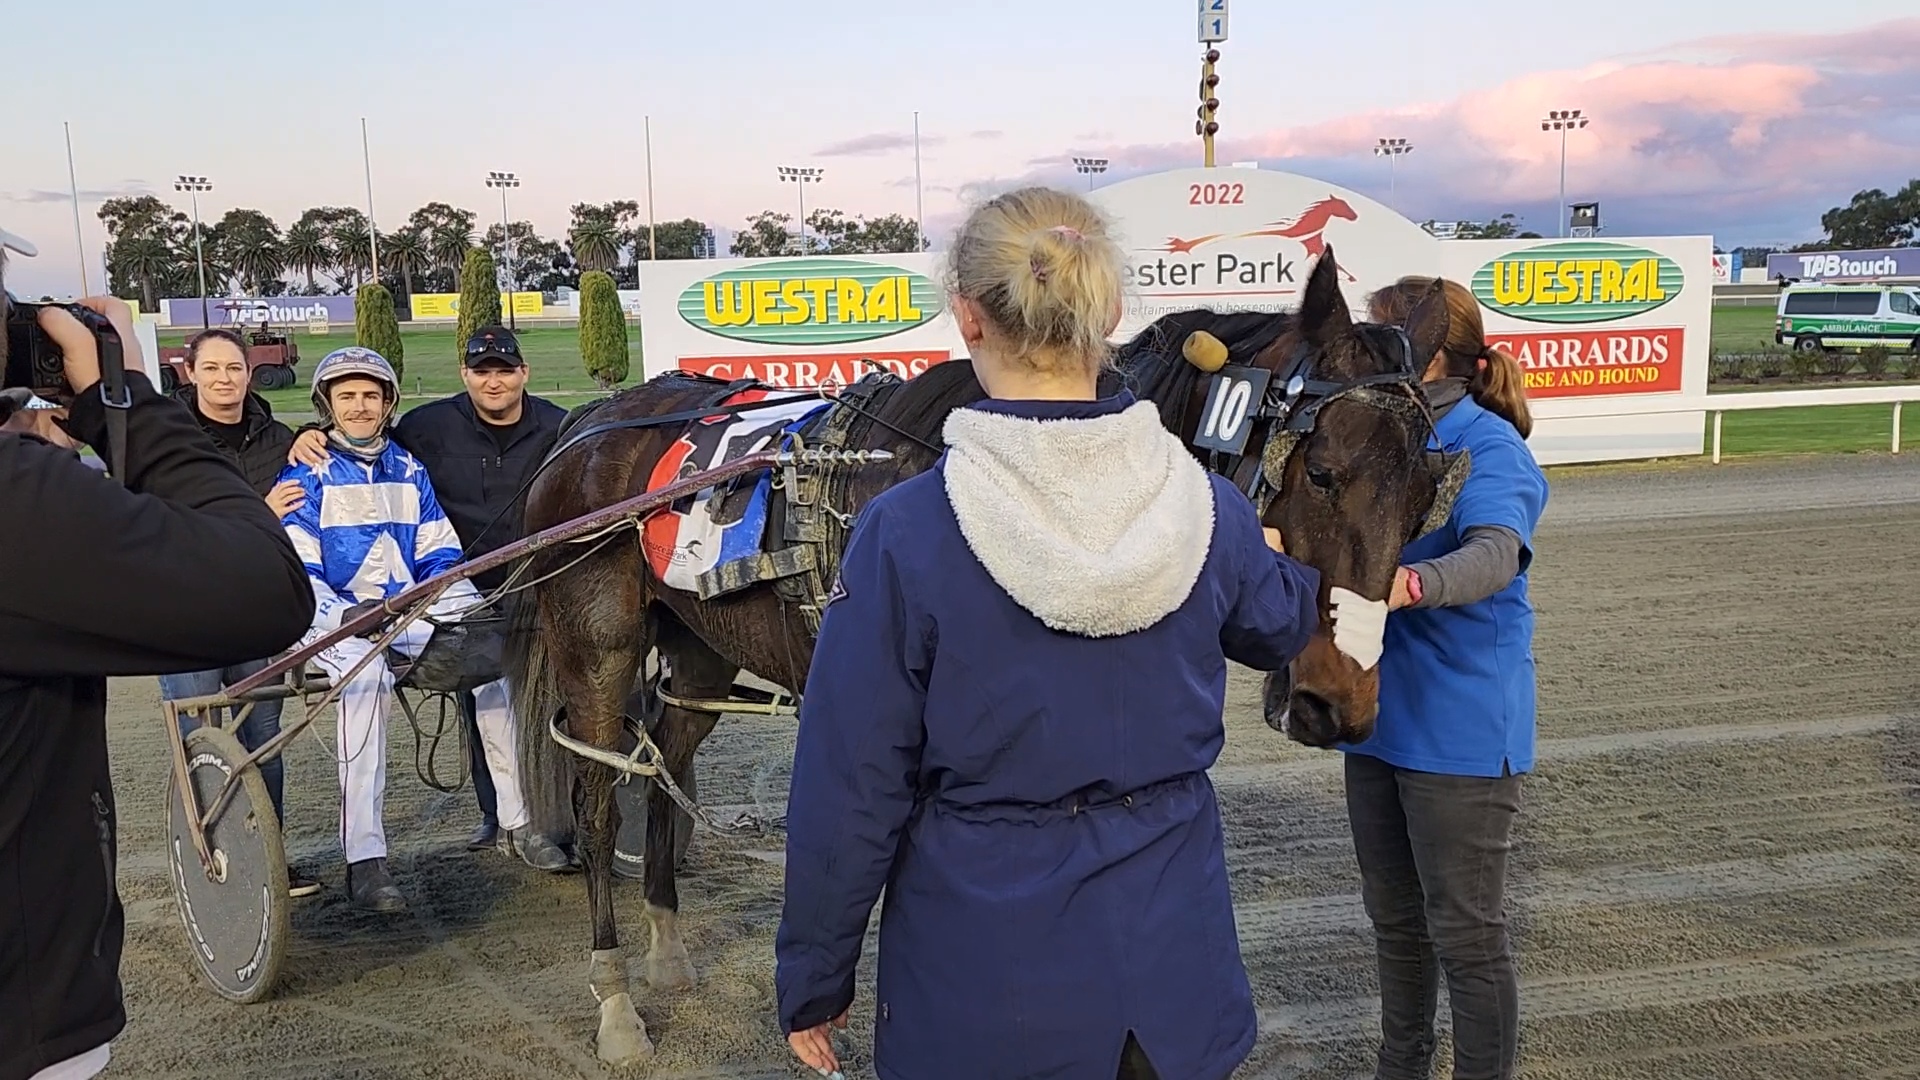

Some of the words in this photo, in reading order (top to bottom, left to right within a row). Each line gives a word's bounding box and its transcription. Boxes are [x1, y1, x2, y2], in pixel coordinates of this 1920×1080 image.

[1211, 18, 1221, 36] 1
[1189, 184, 1244, 205] 2022
[1122, 258, 1205, 286] ester
[1216, 252, 1294, 284] Park
[1799, 254, 1897, 278] TABtouch
[1493, 258, 1667, 305] WESTRAL
[703, 276, 922, 326] WESTRAL
[1822, 322, 1881, 334] AMBULANCE
[1523, 371, 1555, 389] RSE
[1558, 369, 1595, 387] AND
[1599, 366, 1660, 384] HOUND
[1203, 376, 1252, 441] 10
[188, 753, 232, 786] ORIMA
